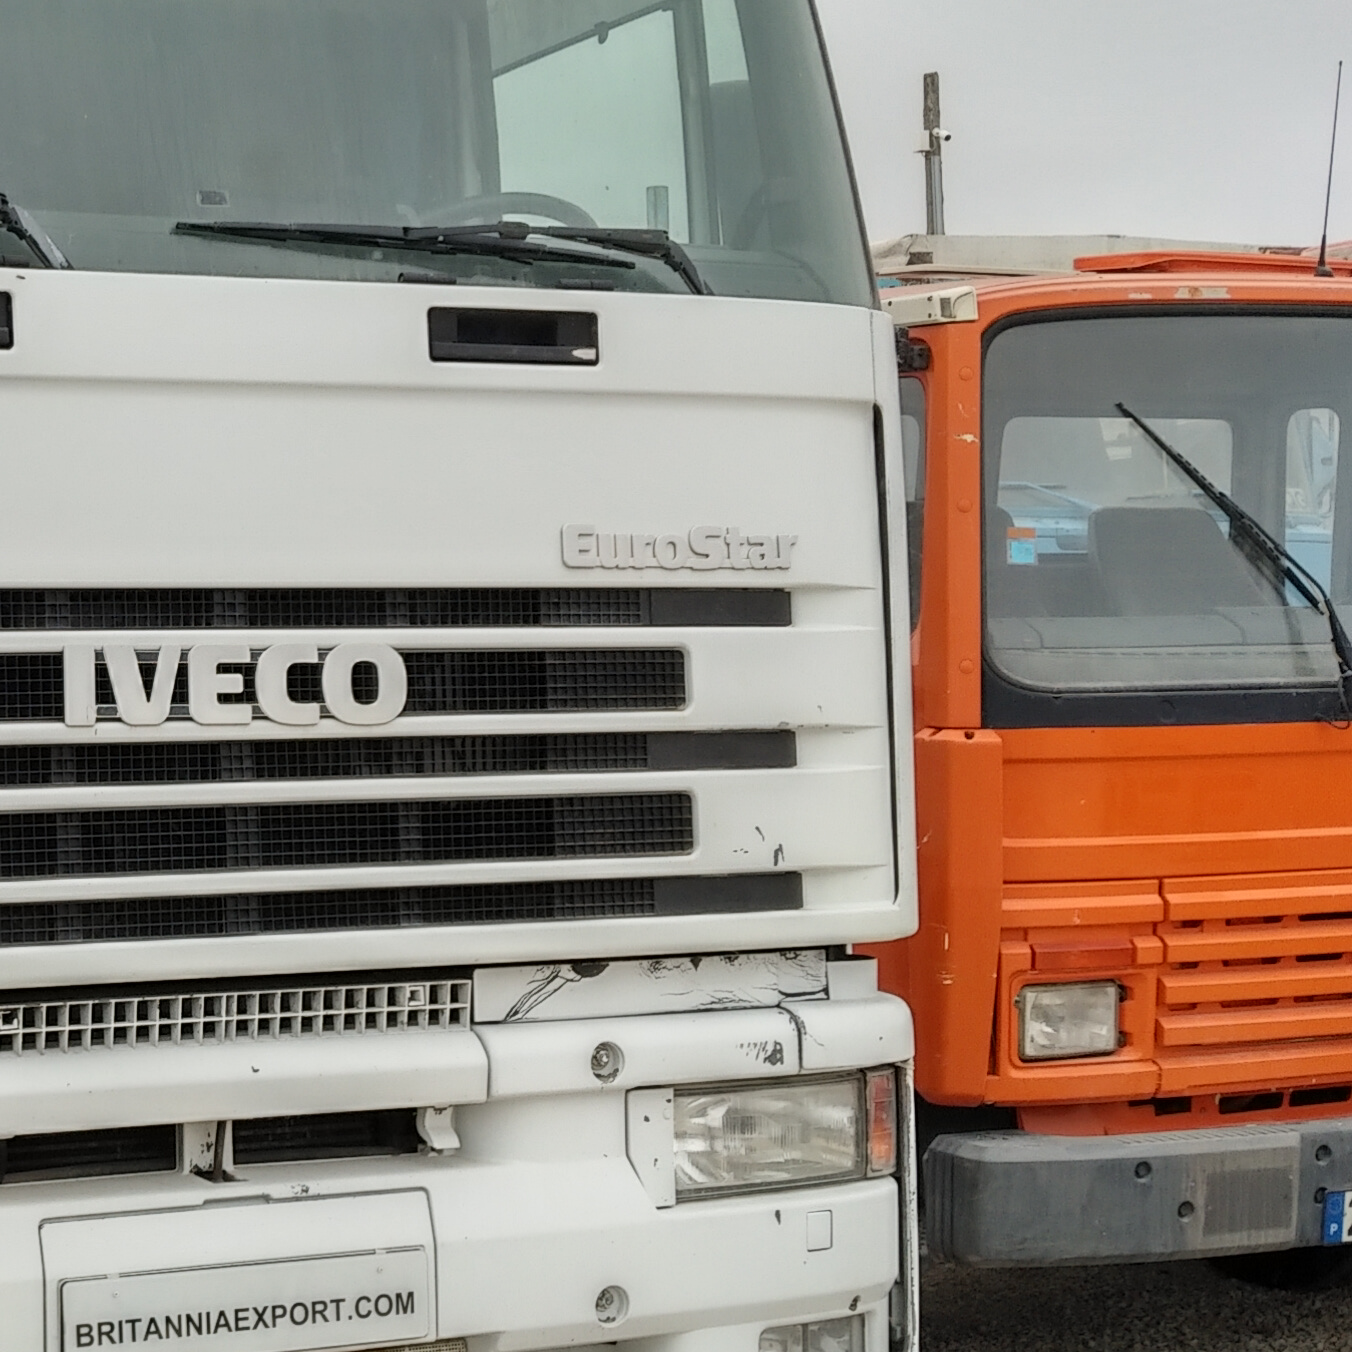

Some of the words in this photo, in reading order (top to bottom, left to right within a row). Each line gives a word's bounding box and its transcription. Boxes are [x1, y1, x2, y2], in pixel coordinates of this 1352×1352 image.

[560, 522, 799, 571] EuroStar
[63, 643, 408, 726] IVECO
[1329, 1223, 1338, 1236] P
[75, 1291, 416, 1348] BRITANNIAEXPORT.COM
